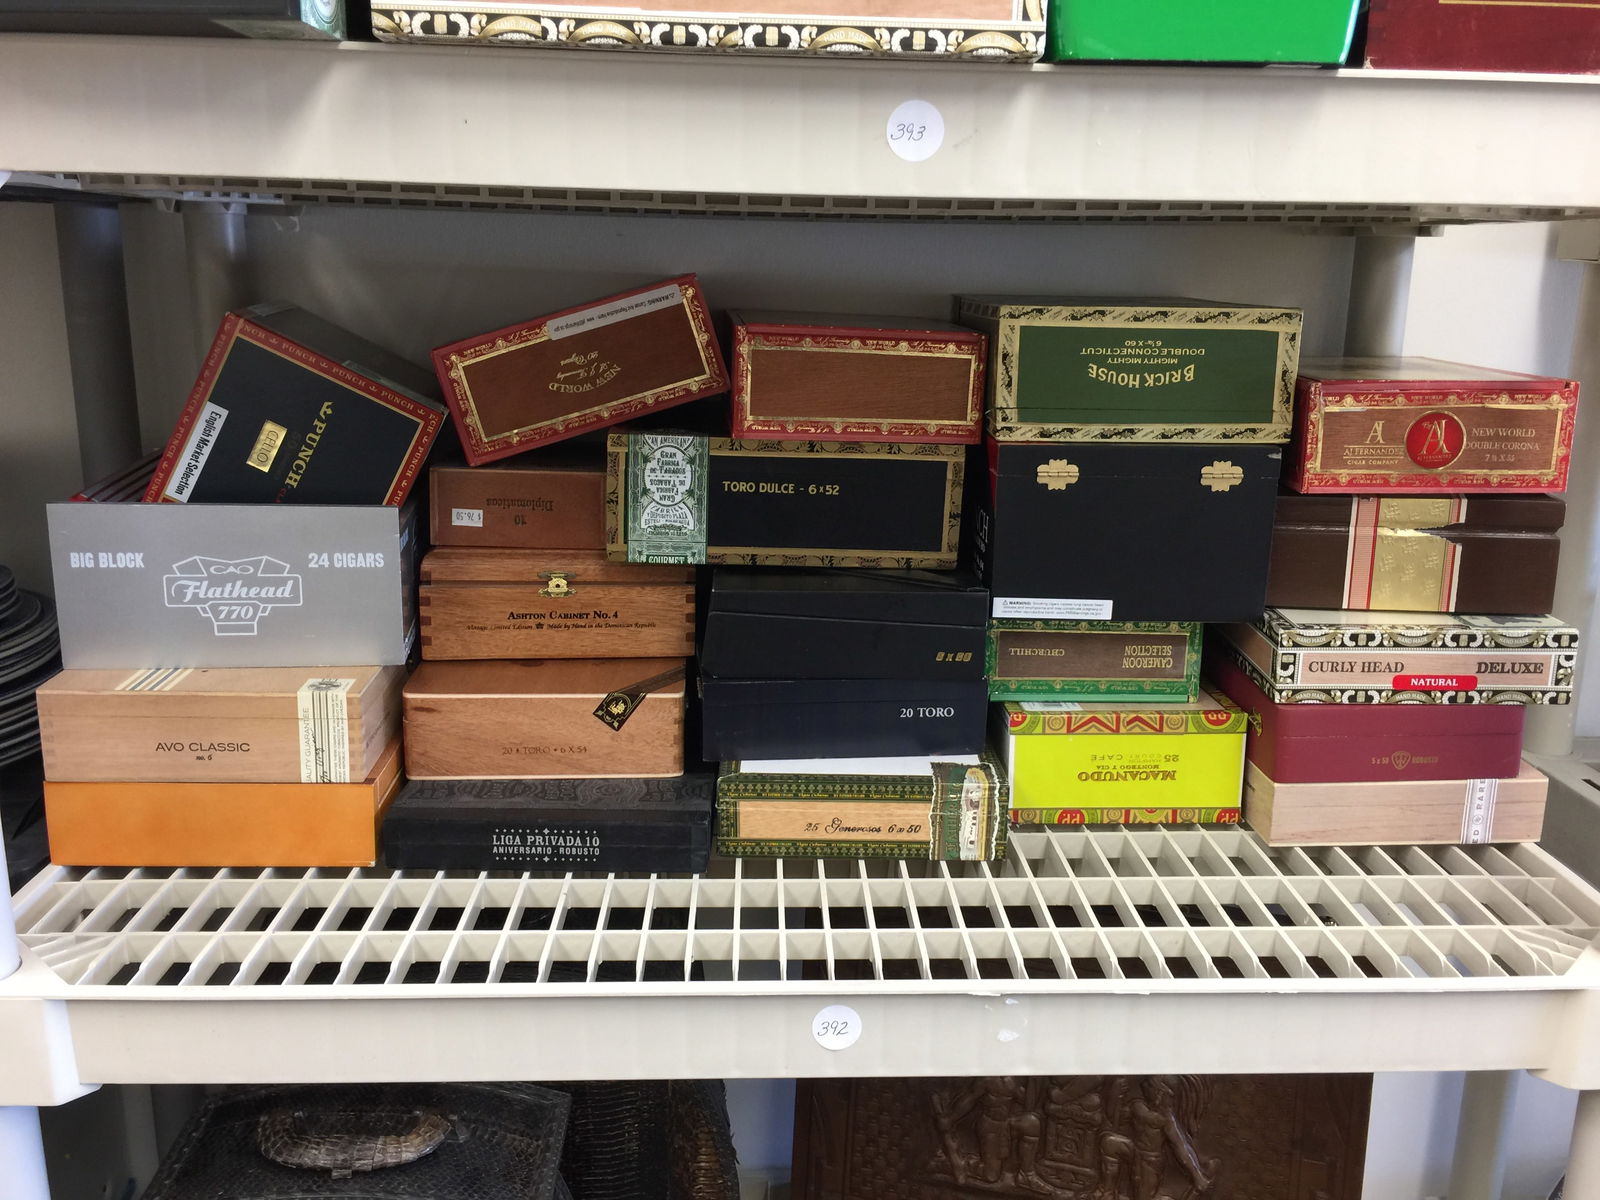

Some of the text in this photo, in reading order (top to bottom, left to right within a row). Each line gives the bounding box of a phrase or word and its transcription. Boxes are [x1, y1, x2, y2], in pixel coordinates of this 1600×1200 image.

[890, 122, 926, 142] 393
[282, 343, 414, 410] PUNCH PUNCH PUNCH
[596, 364, 621, 386] NEW
[1087, 363, 1195, 388] BRICK HOUSE
[549, 381, 595, 393] WORLD
[1472, 428, 1536, 438] NEW WORLD
[167, 427, 185, 458] PUNCH
[1500, 442, 1540, 450] CORONA
[174, 411, 222, 495] English Market Selection
[285, 418, 327, 488] PUNCH
[660, 451, 677, 459] GRAN
[405, 447, 424, 477] PUNCH
[657, 459, 680, 467] FABRICA
[659, 466, 687, 475] TABACOS
[649, 479, 678, 488] TABACOS
[722, 481, 756, 492] TORO
[759, 483, 795, 494] DULCE
[656, 487, 679, 496] FABRICA
[659, 495, 676, 503] GRAN
[514, 515, 527, 525] 10
[70, 552, 145, 568] BIG BLOCK
[308, 552, 384, 568] 24 CIGARS
[210, 565, 254, 575] CAO
[171, 580, 294, 602] Flathead
[217, 604, 254, 619] 770
[507, 611, 590, 620] ASHTON CABINET
[1009, 648, 1065, 656] CHURCHILL
[1125, 645, 1172, 656] SELECTION
[1122, 657, 1173, 668] CAMEROON
[1308, 661, 1404, 673] CURLY HEAD
[1476, 662, 1544, 674] DELUXE
[1410, 678, 1459, 687] NATURAL
[900, 707, 955, 718] 20 TORO
[303, 707, 311, 757] GUARANTEE
[155, 742, 250, 752] AVO CLASSIC
[502, 747, 513, 755] 20
[523, 746, 550, 754] TORO
[1164, 754, 1179, 762] 25
[1077, 771, 1177, 782] MACANUDO
[804, 822, 819, 832] 25
[825, 817, 882, 834] Generosos
[888, 824, 896, 833] 6
[906, 824, 921, 834] 50
[492, 835, 600, 847] LIGA PRIVADA 10
[492, 846, 600, 855] ANIVERSARIO ROBUSTO
[817, 1021, 850, 1036] 392
